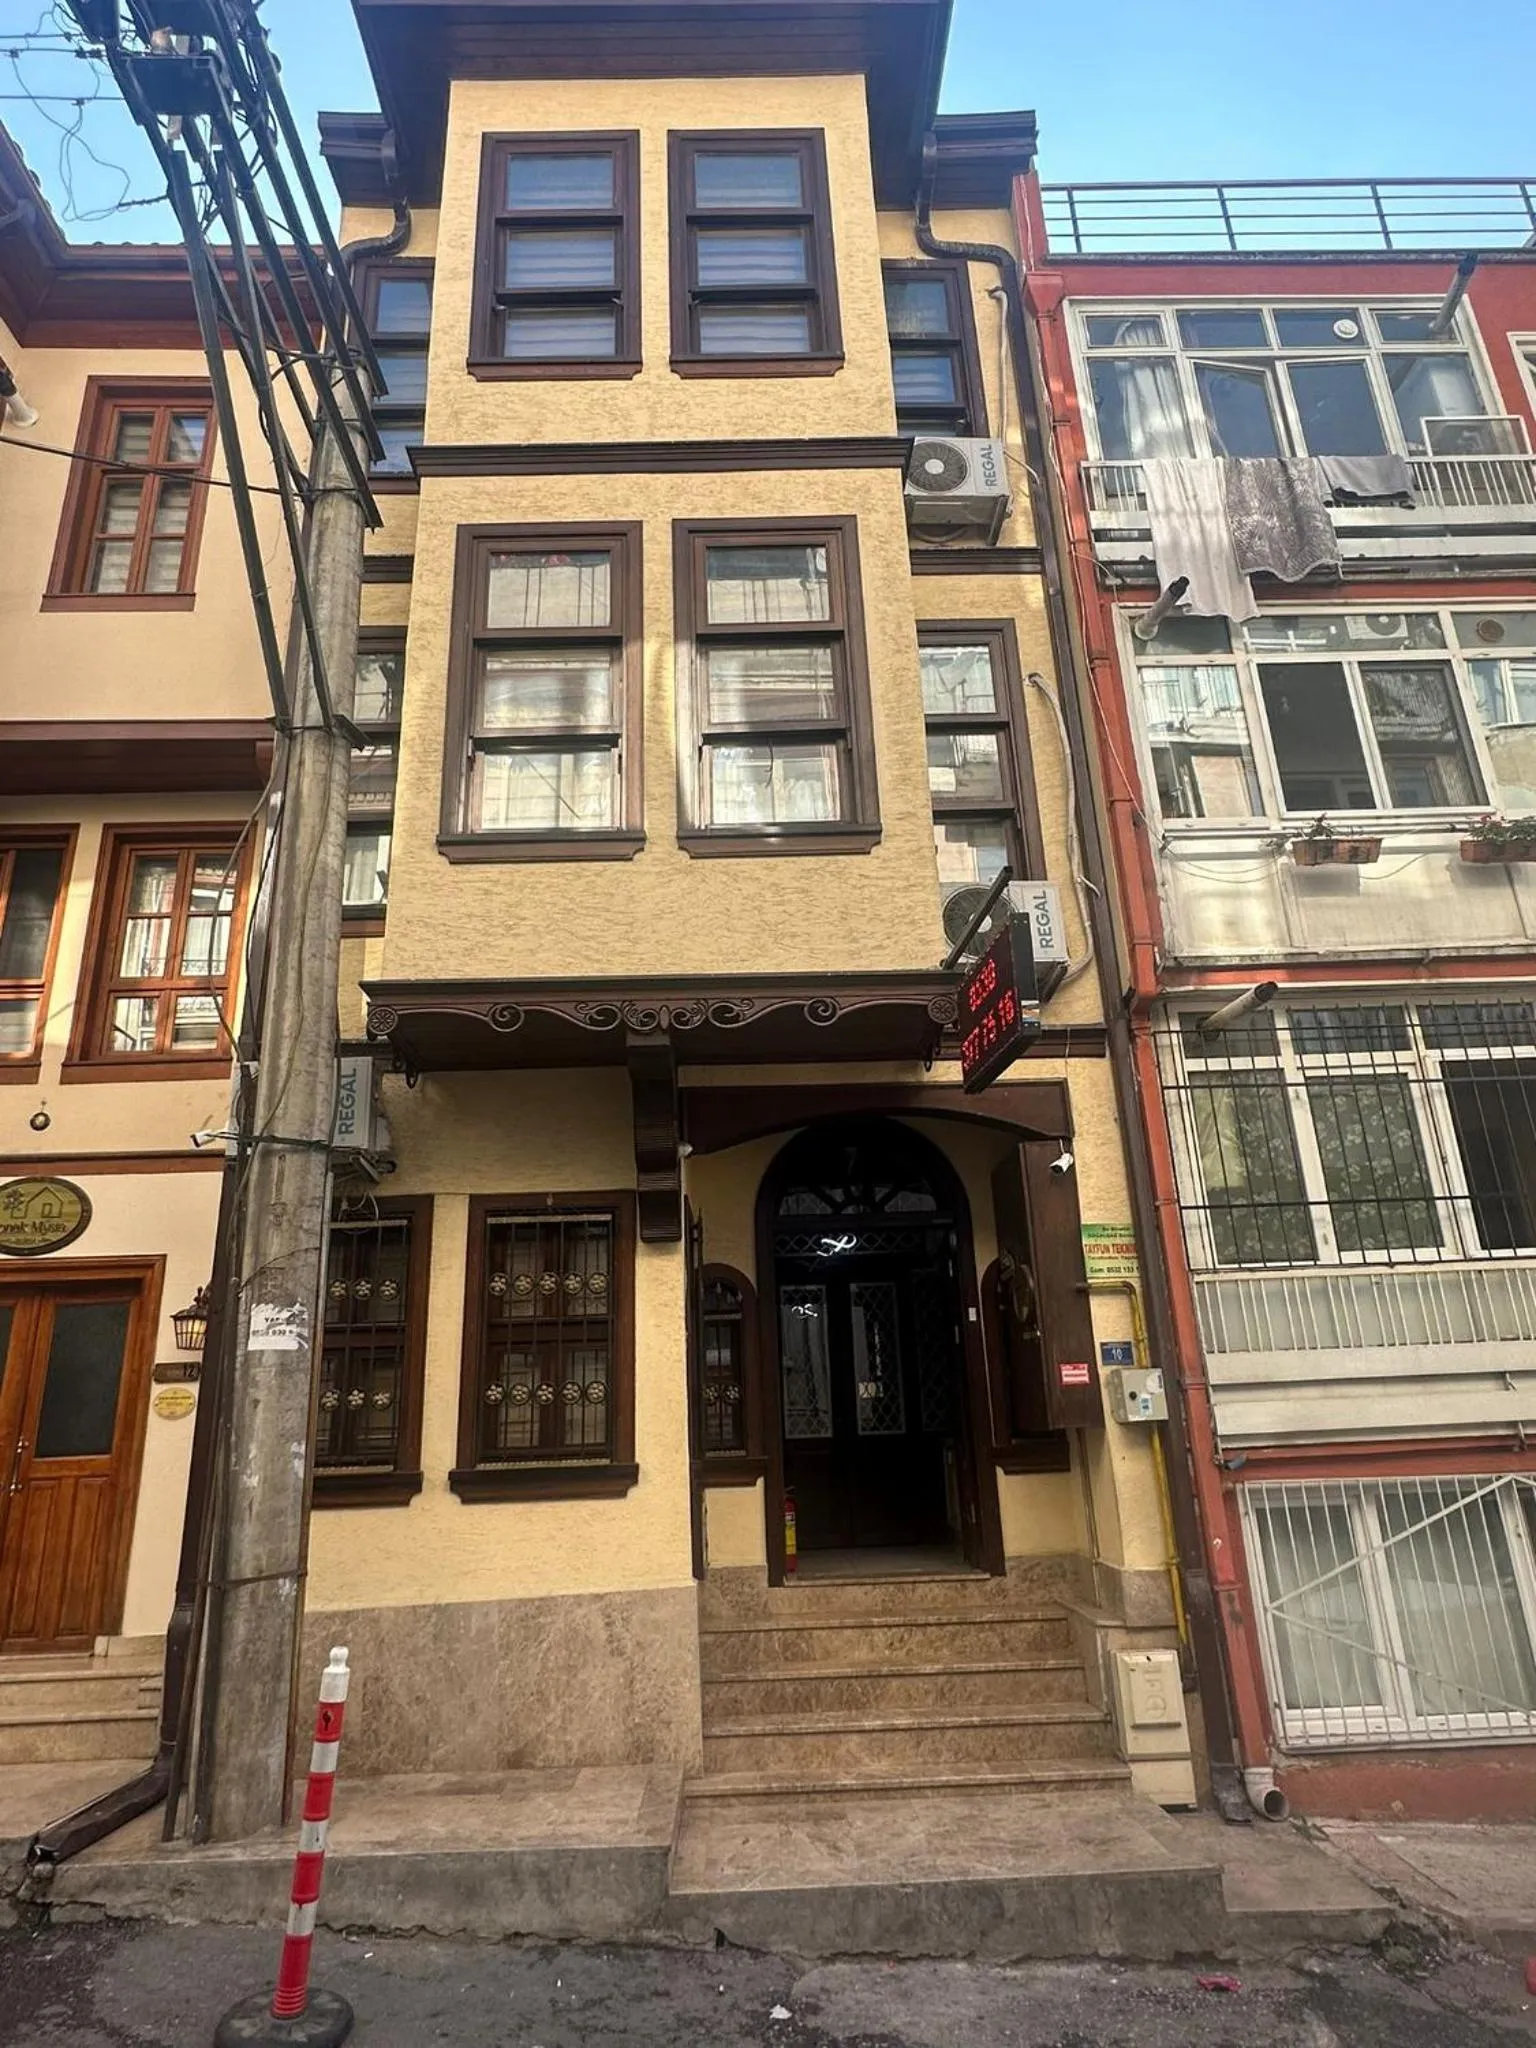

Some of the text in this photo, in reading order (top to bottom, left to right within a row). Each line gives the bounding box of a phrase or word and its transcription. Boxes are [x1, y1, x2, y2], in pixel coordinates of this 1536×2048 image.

[980, 444, 997, 486] REGAL
[1033, 890, 1054, 948] REGAL
[338, 1068, 357, 1135] REGAL
[183, 1364, 195, 1378] 12
[1112, 1348, 1123, 1360] 10
